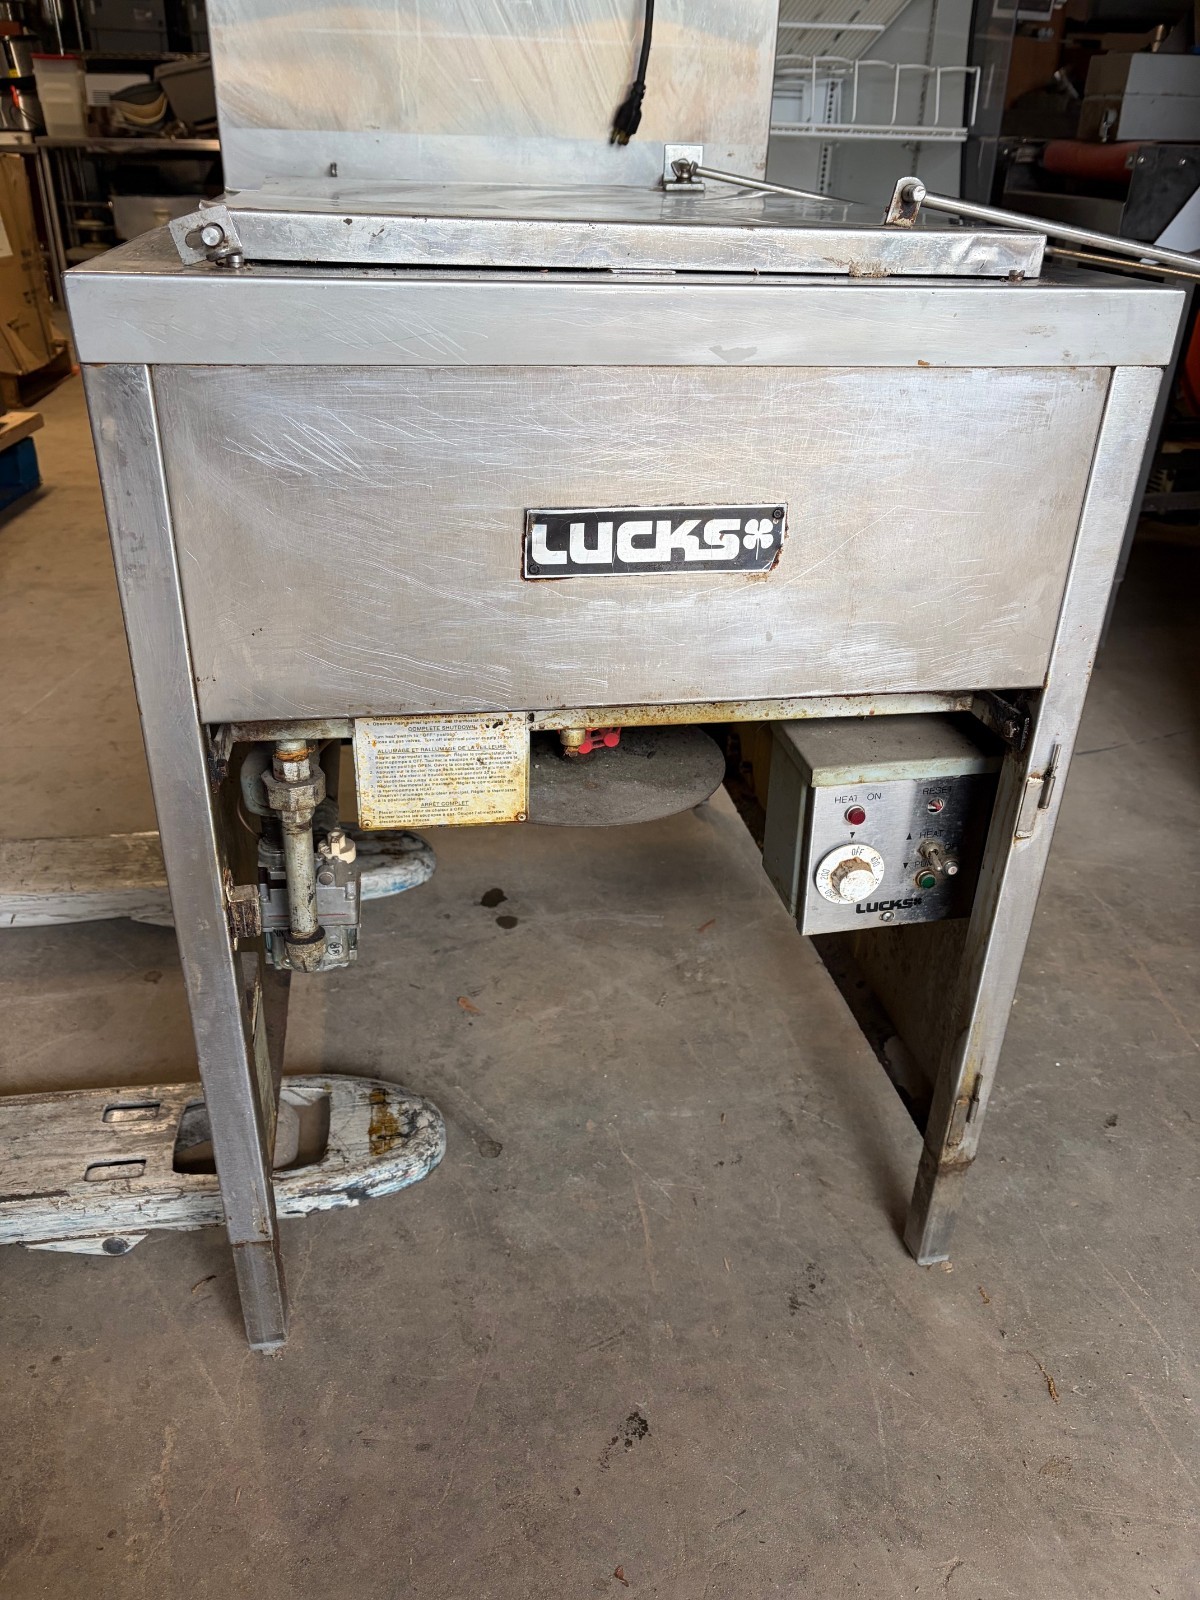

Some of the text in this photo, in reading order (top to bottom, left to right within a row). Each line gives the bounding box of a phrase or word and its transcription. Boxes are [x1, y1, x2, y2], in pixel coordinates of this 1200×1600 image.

[532, 518, 741, 564] LUCKS
[922, 786, 952, 795] RESET
[834, 792, 882, 804] HEAT ON
[920, 829, 944, 839] HEAT
[851, 847, 865, 857] OFF
[855, 899, 915, 914] LUCKS
